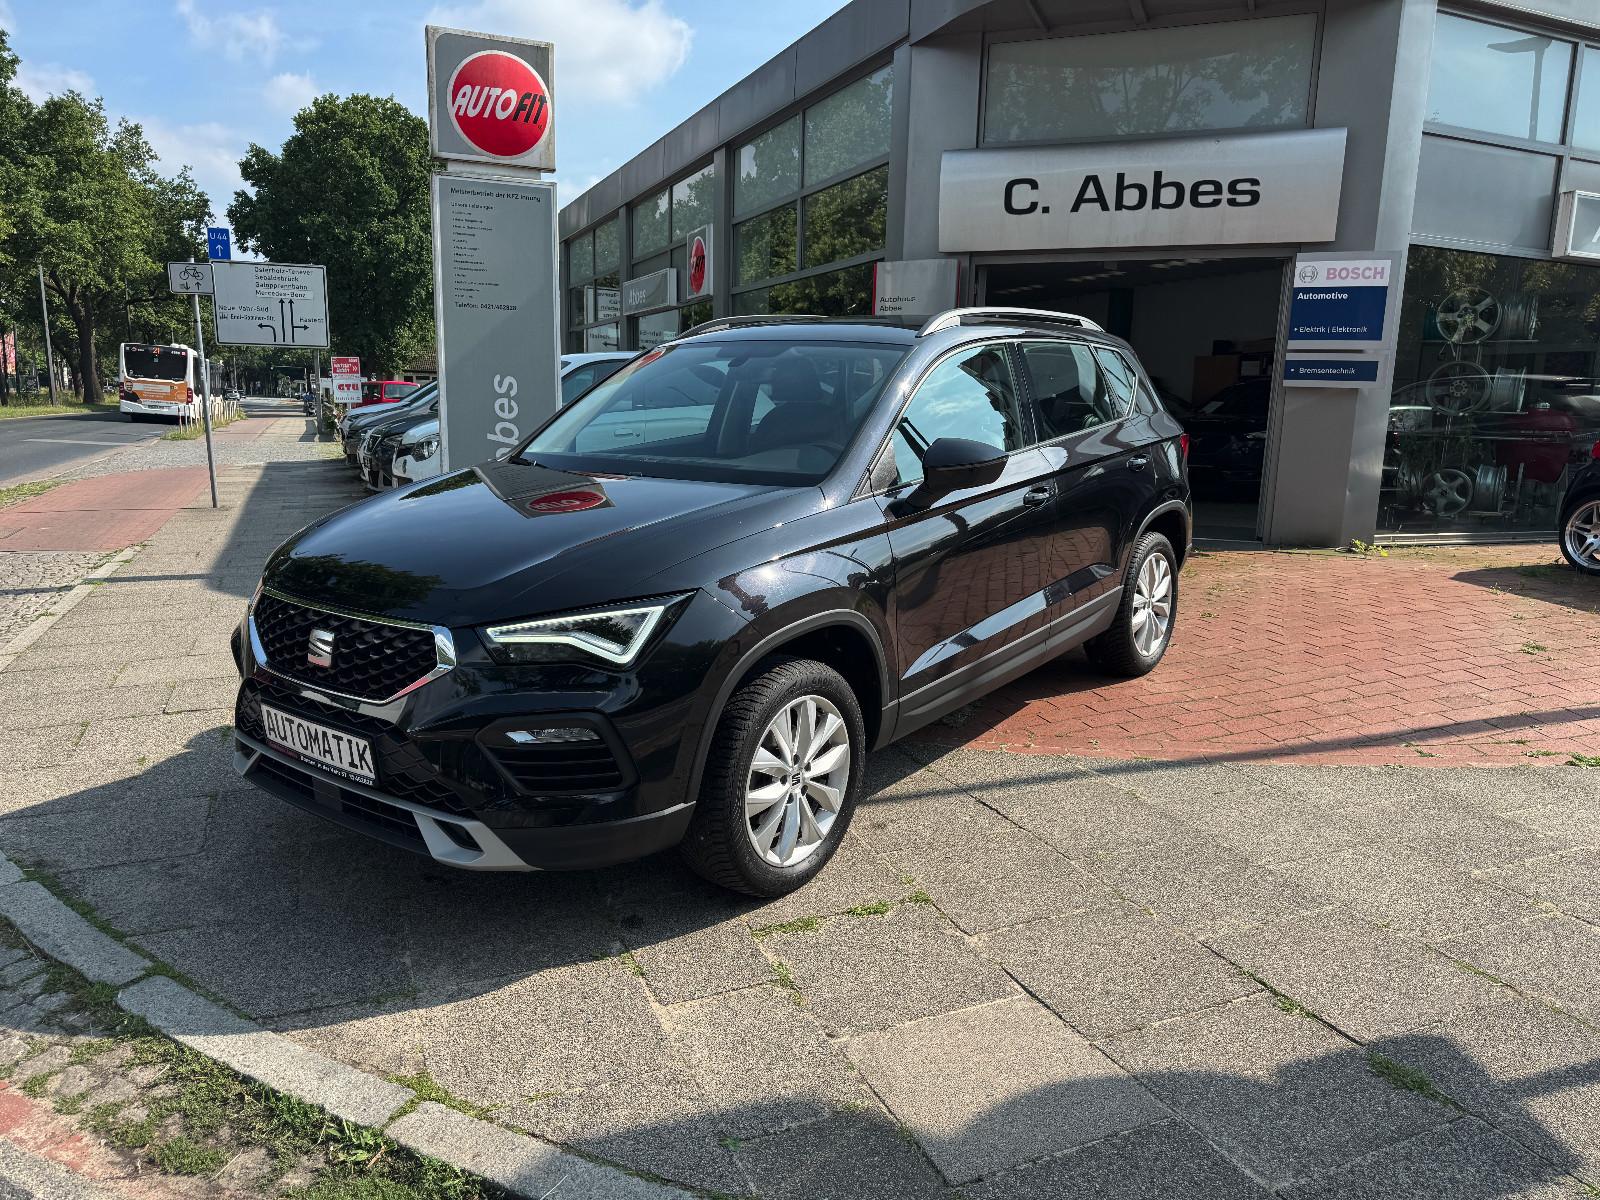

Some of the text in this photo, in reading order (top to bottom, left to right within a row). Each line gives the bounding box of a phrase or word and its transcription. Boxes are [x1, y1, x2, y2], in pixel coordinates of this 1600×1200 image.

[452, 84, 548, 124] AUTOFIT
[1003, 170, 1261, 216] C. Abbes
[1326, 266, 1385, 280] BOSCH
[1297, 292, 1348, 300] Automotive
[266, 710, 374, 774] AUTOMATIK
